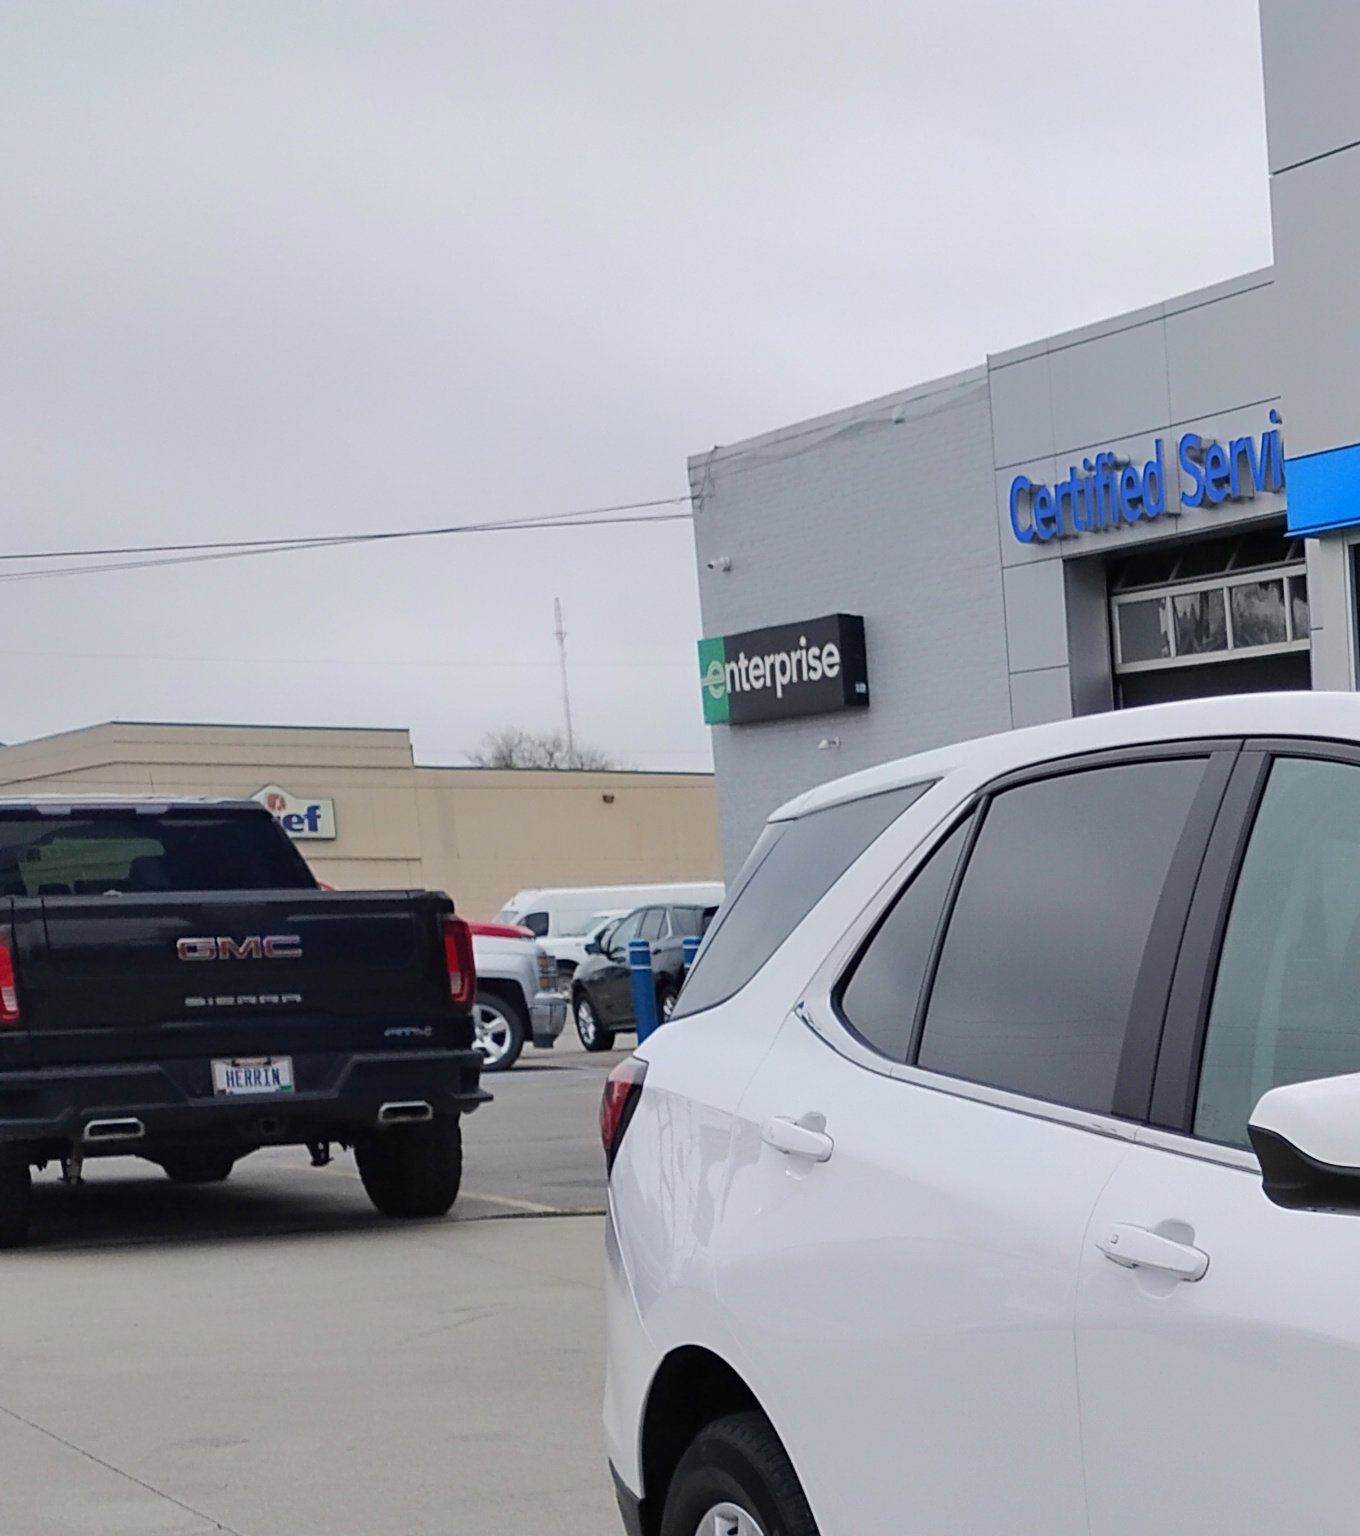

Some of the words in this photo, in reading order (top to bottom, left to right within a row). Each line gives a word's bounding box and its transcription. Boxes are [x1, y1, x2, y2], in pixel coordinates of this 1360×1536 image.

[1010, 438, 1166, 544] Certified
[1180, 408, 1285, 508] Servi
[702, 635, 841, 699] enterprise
[282, 804, 322, 833] ef
[176, 934, 303, 961] GMC
[225, 1066, 280, 1088] HERRIN
